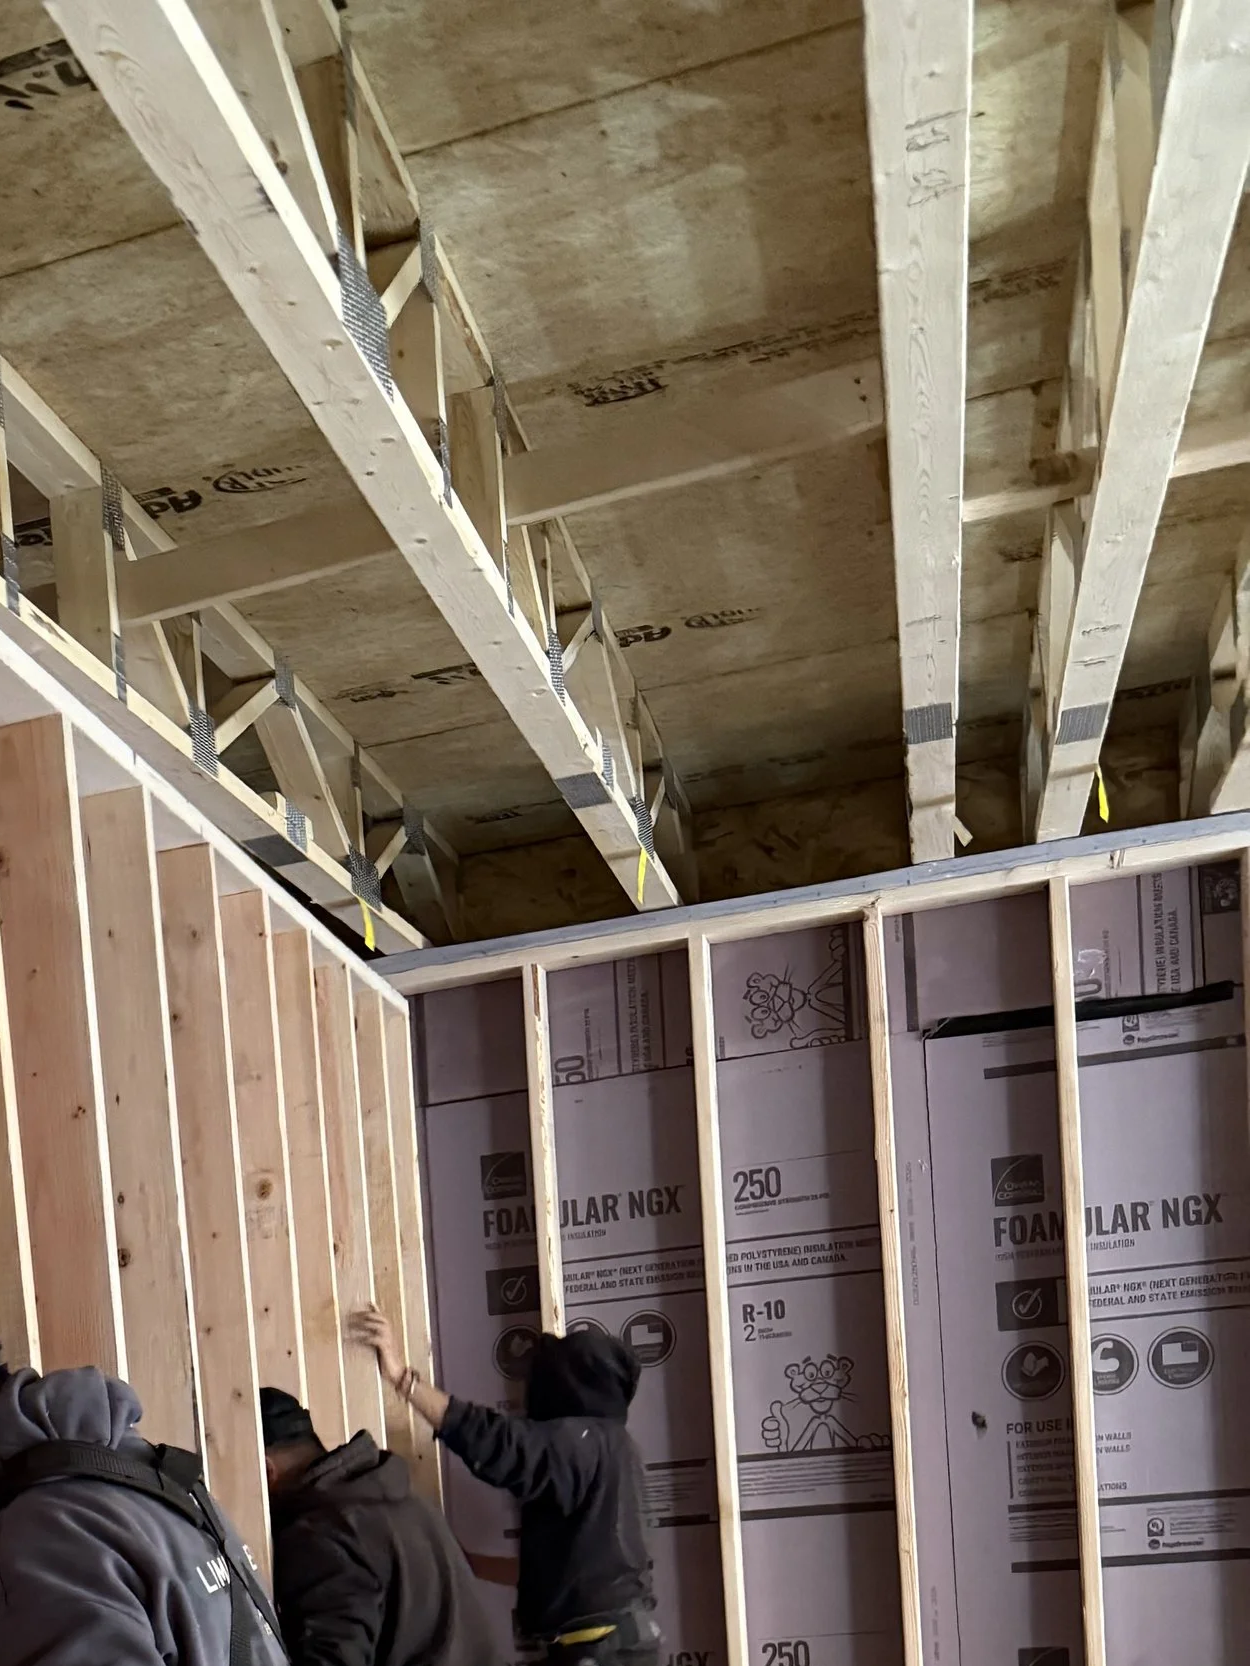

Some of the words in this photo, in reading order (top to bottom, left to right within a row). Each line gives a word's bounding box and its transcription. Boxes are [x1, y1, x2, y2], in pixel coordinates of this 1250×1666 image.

[732, 1165, 783, 1204] 250
[628, 1184, 684, 1220] NGX
[1161, 1191, 1225, 1230] NGX
[1090, 1238, 1136, 1252] INSULATION
[740, 1246, 802, 1263] POLYSTYRENE)
[755, 1260, 772, 1272] THE
[772, 1258, 791, 1270] USA
[791, 1256, 810, 1268] AND
[1148, 1277, 1177, 1291] (NEXT
[1127, 1295, 1147, 1306] AND
[1147, 1291, 1179, 1304] STATE
[741, 1298, 787, 1325] R-10
[743, 1323, 757, 1343] 2
[1005, 1422, 1033, 1436] FOR
[1036, 1418, 1063, 1433] USE
